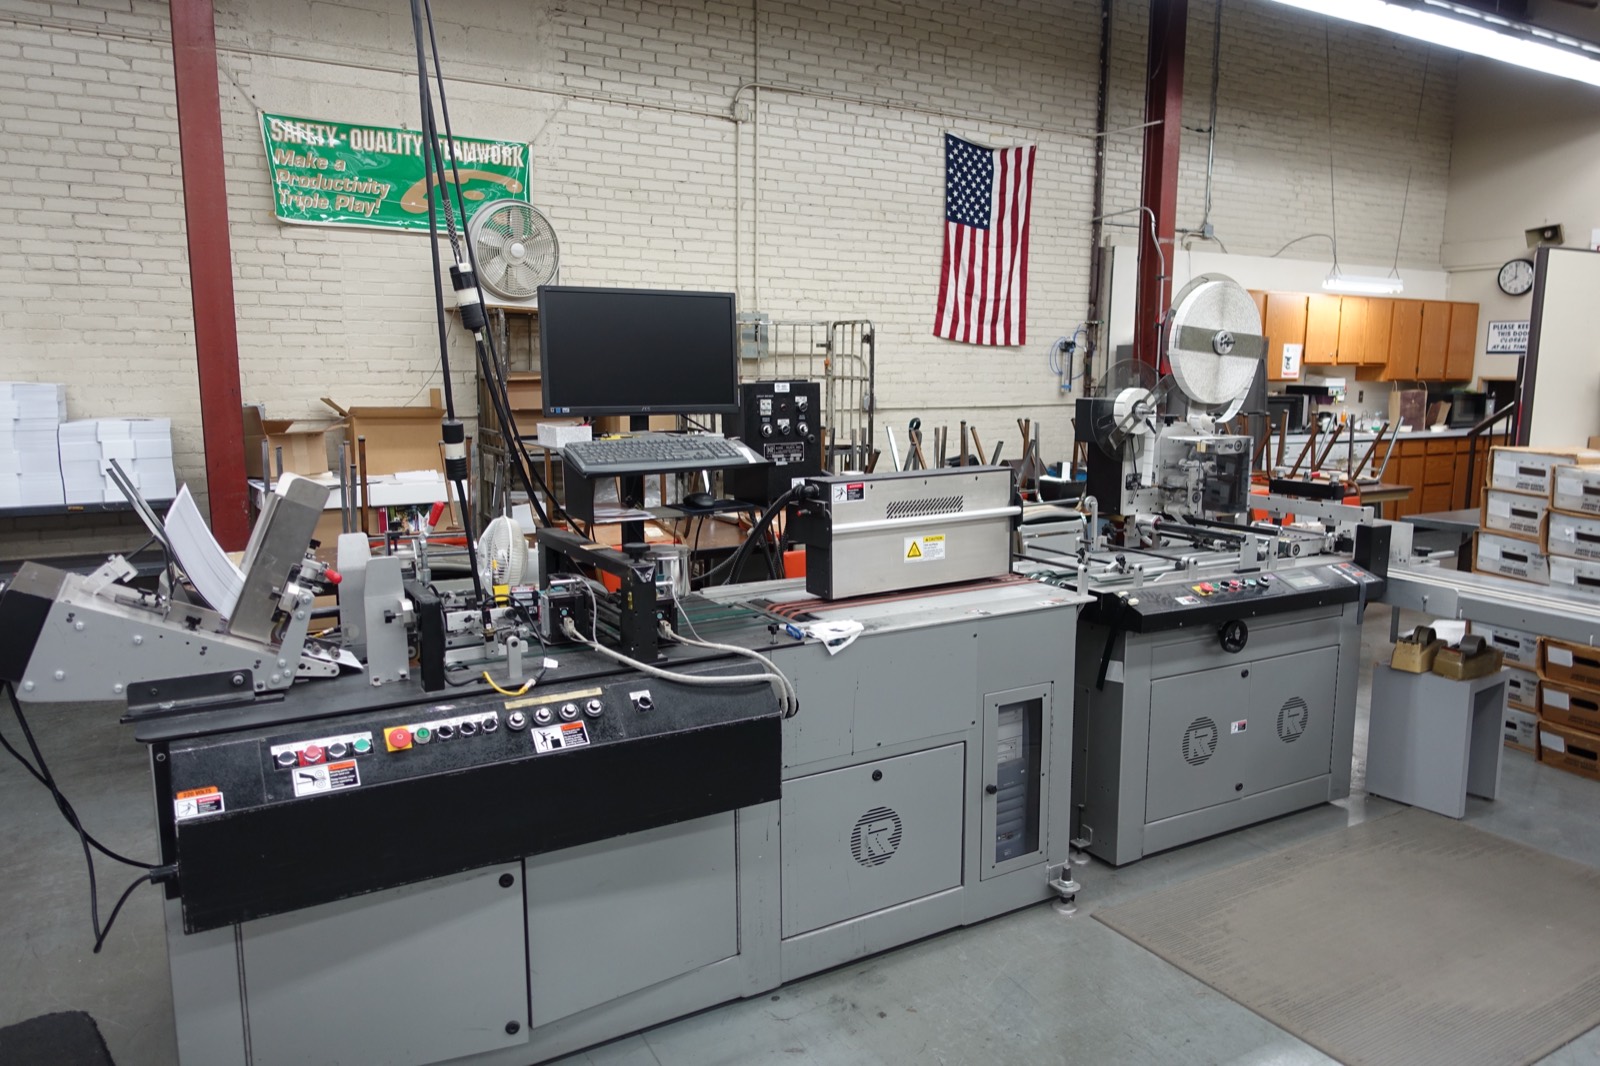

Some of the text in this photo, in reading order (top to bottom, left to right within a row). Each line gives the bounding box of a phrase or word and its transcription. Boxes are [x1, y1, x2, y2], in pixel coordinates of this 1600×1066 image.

[270, 118, 338, 148] SAFETY
[350, 128, 422, 156] QUALITY
[274, 148, 346, 172] Make a
[276, 169, 391, 200] Productivity
[279, 188, 382, 218] Triple Play!
